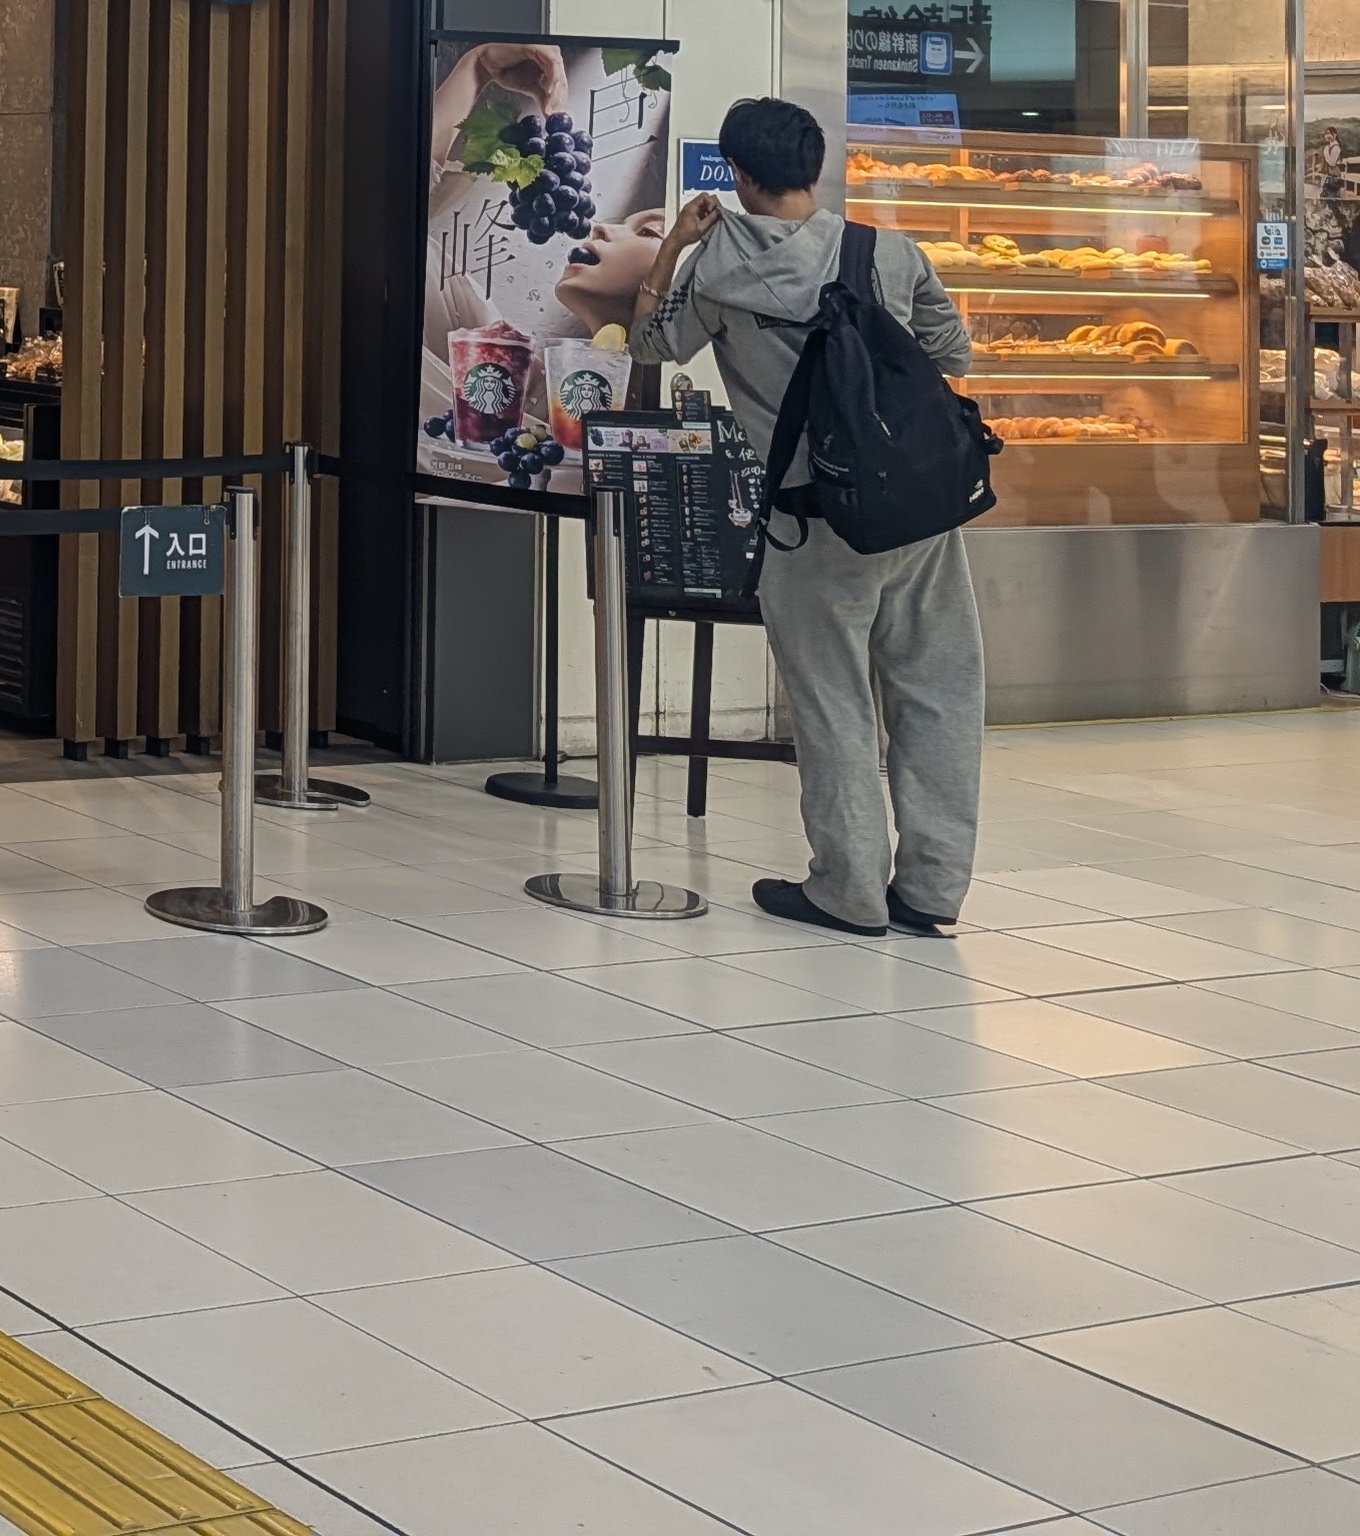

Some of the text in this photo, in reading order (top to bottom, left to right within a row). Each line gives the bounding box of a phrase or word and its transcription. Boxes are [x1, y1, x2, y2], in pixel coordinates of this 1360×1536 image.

[700, 165, 734, 181] DON
[440, 199, 516, 302] 峰
[165, 533, 206, 557] 入口
[166, 560, 207, 569] ENTRANCE
